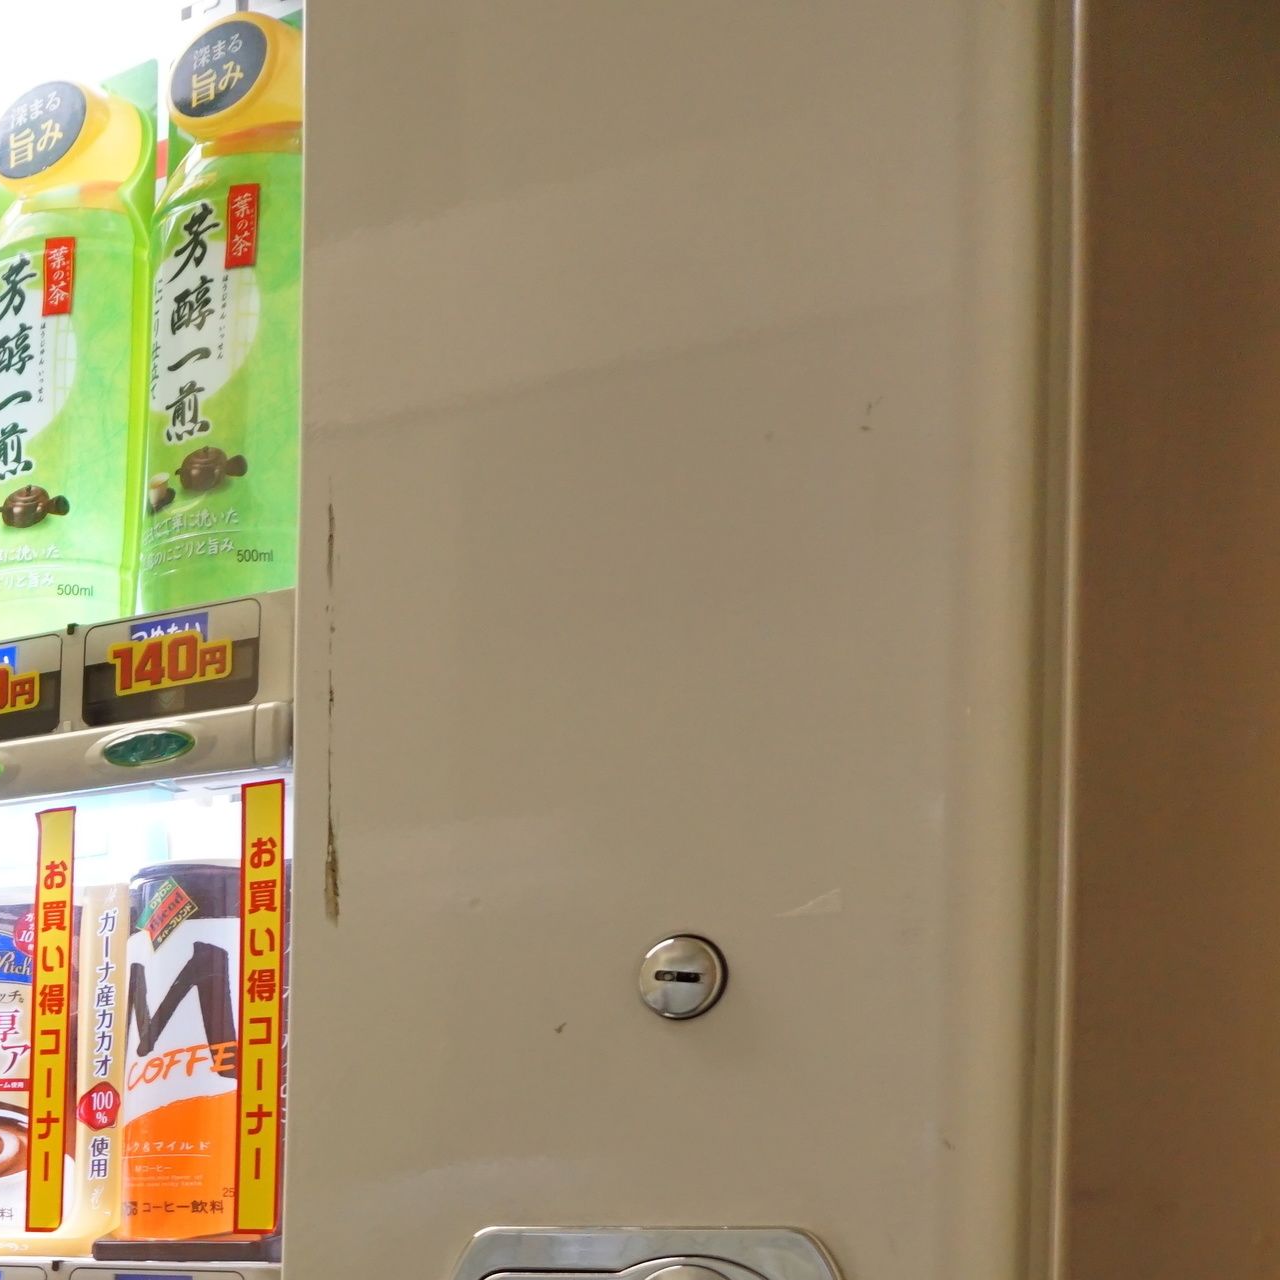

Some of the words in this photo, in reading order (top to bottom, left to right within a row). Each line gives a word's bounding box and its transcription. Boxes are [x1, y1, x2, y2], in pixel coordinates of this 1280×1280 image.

[192, 32, 243, 69] 深まる
[191, 60, 245, 108] 旨み
[10, 91, 61, 129] 深まる
[9, 119, 63, 169] 旨み
[231, 192, 252, 257] 葉の茶
[47, 246, 70, 306] 葉の茶
[166, 201, 220, 442] 芳醇一煎
[236, 549, 273, 563] 500ml
[56, 584, 94, 597] 500ml
[112, 634, 228, 690] 140円
[94, 906, 119, 1079] ガーナ産カカオ
[245, 836, 279, 1181] お買い得コーナー
[36, 859, 69, 1183] お買い得コーナー
[91, 1091, 115, 1112] 100
[95, 1111, 109, 1125] %
[88, 1137, 111, 1180] 使用
[142, 1200, 224, 1215] コーヒー飲料
